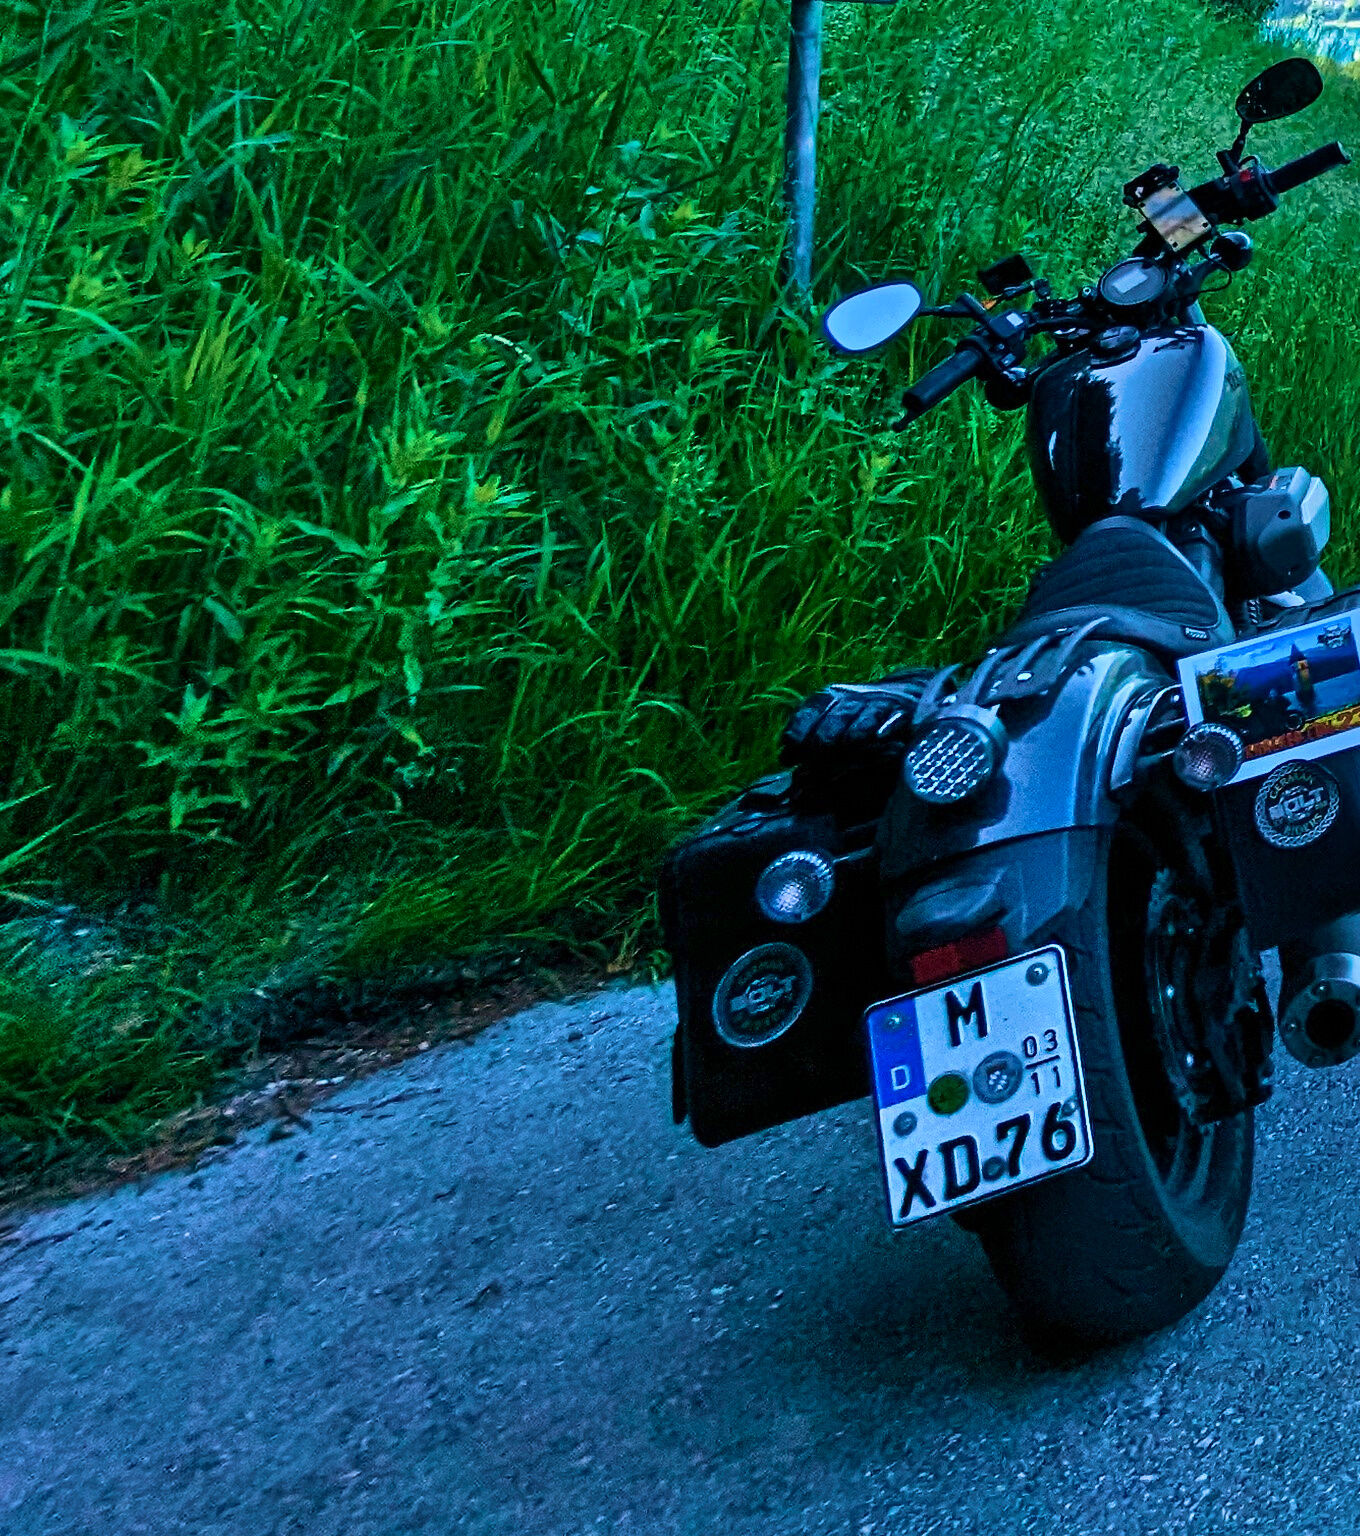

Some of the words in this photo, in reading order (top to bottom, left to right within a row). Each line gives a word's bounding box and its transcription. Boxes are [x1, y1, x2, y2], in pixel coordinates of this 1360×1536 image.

[944, 980, 989, 1048] M
[1022, 1028, 1059, 1058] 03
[890, 1064, 911, 1091] D
[1029, 1065, 1062, 1096] 11
